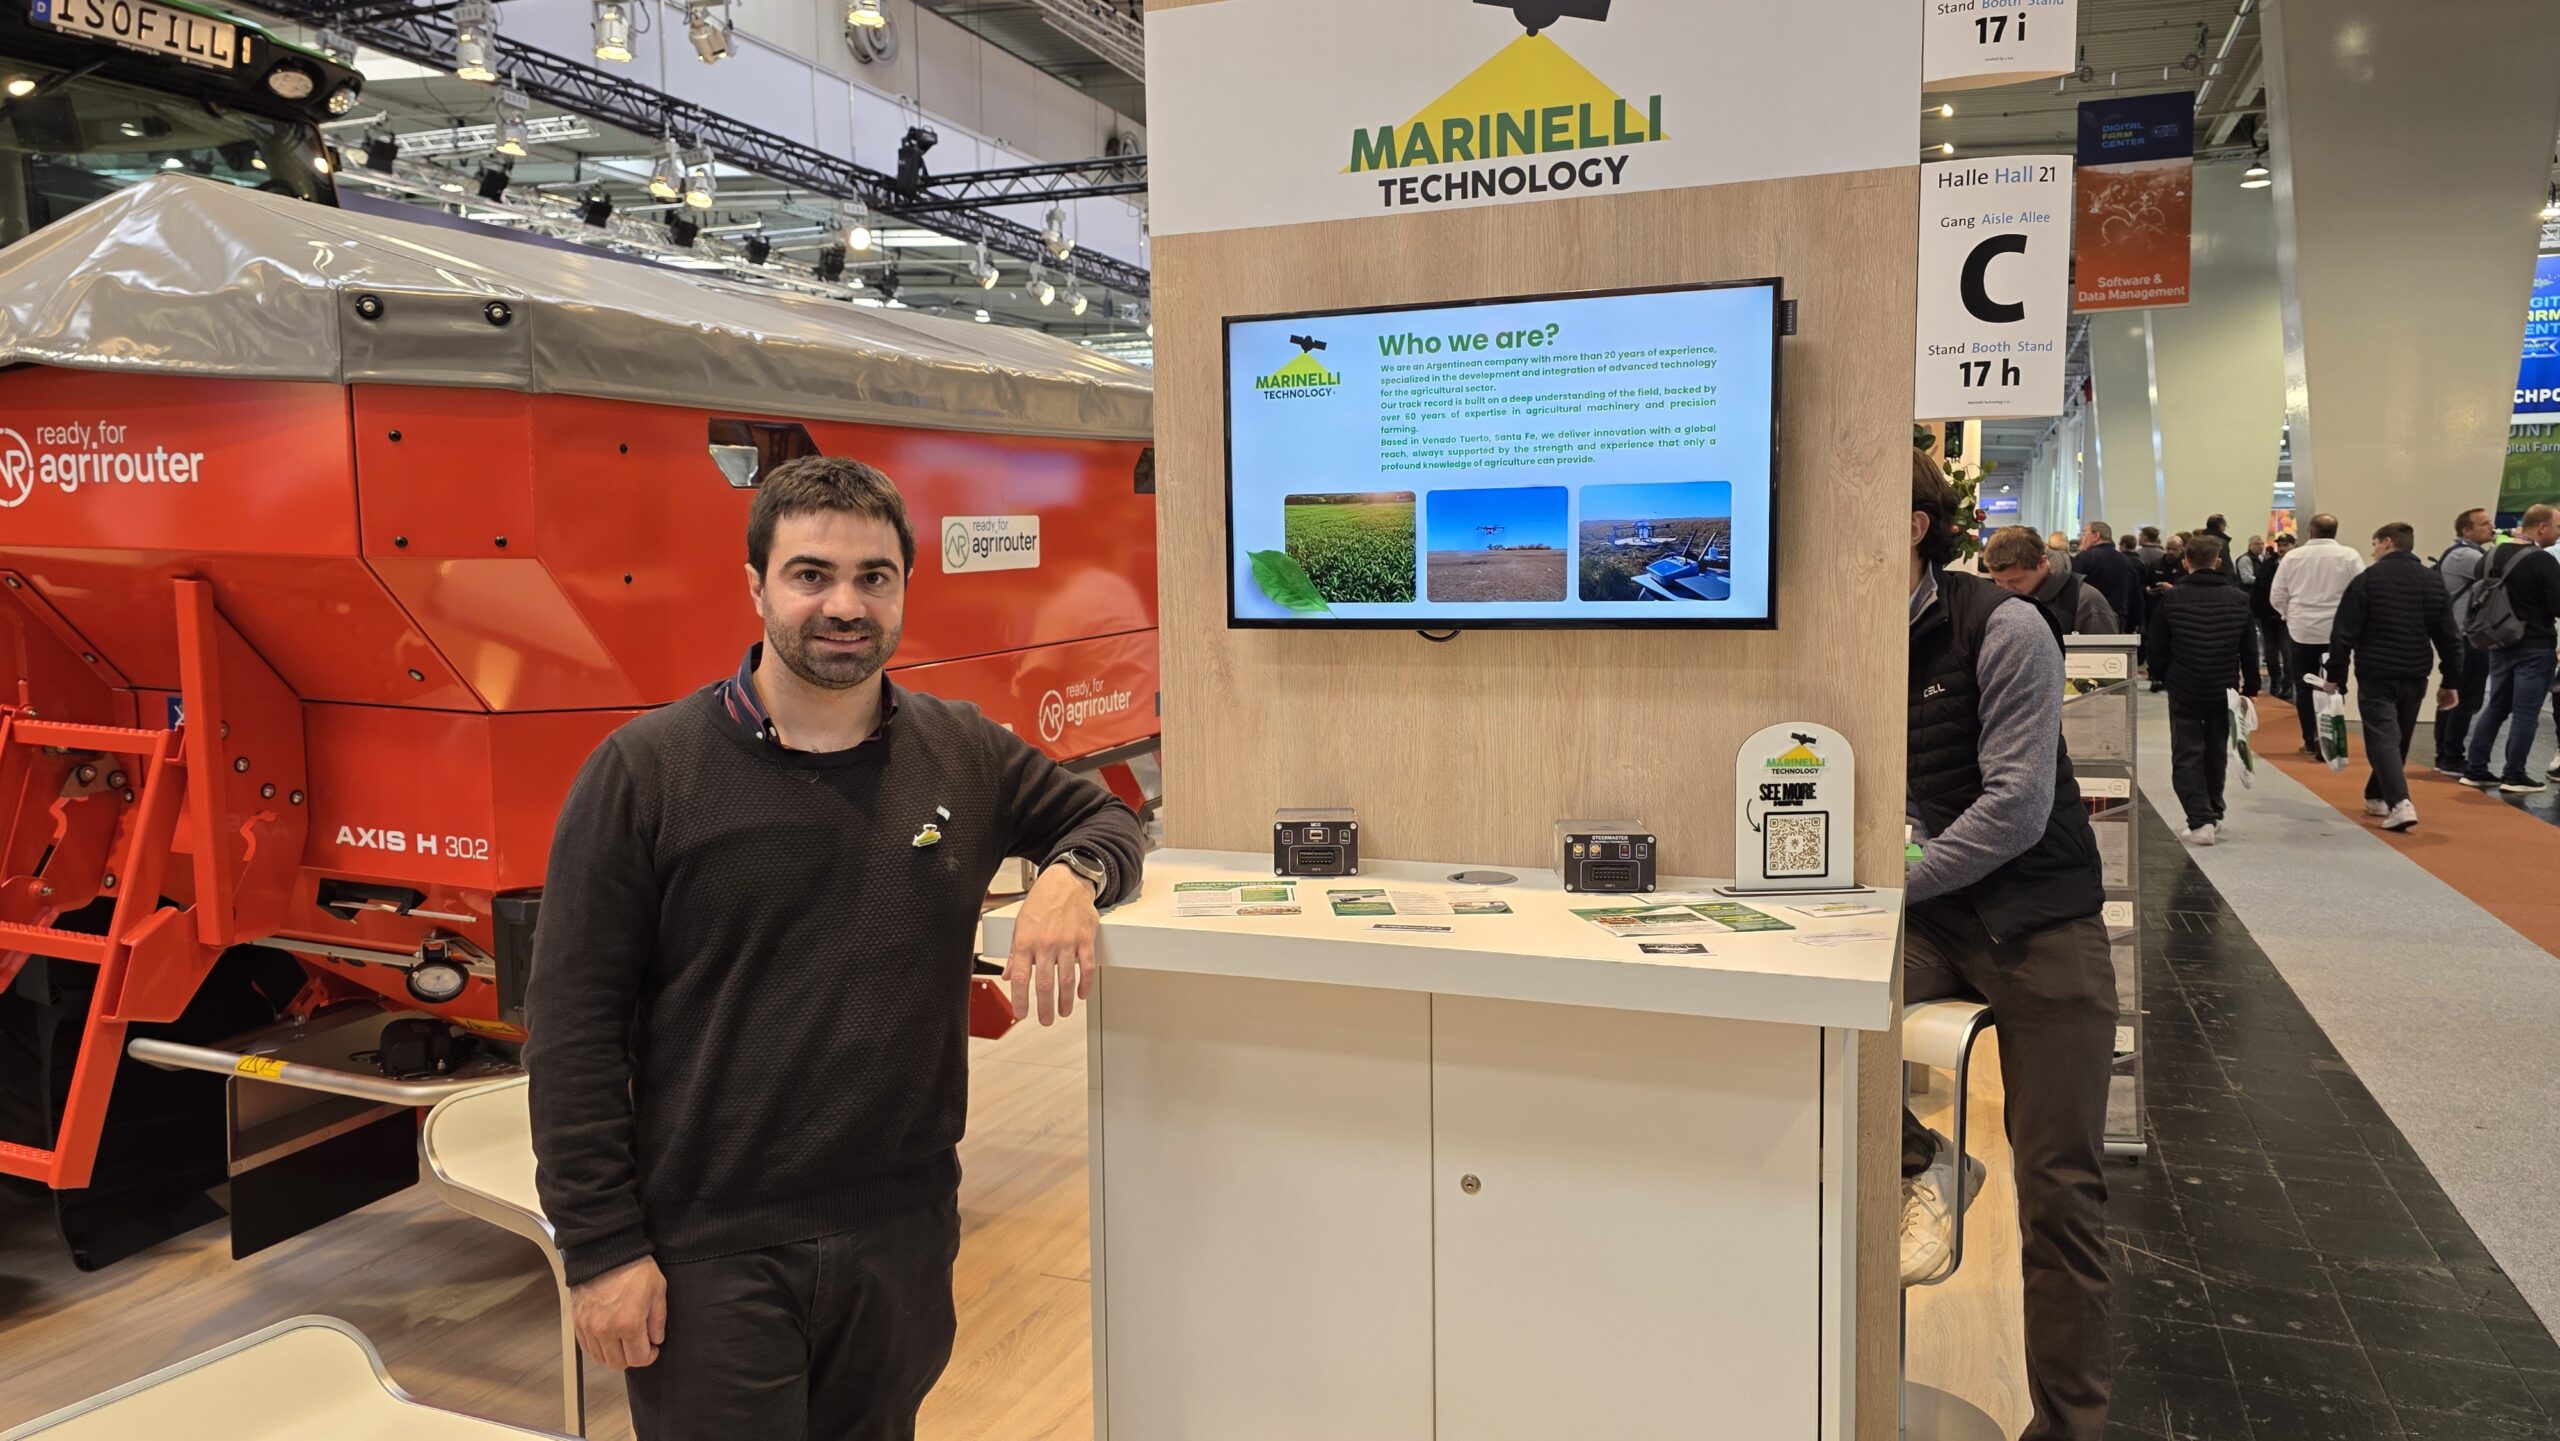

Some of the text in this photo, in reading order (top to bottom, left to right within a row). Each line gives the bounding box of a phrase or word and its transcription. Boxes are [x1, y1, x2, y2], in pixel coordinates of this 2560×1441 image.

[1937, 0, 1975, 15] Stand
[1975, 12, 2026, 44] 17 i
[1350, 95, 1662, 173] MARINELLI
[2101, 121, 2144, 133] DIGITAL
[2101, 130, 2133, 141] FARM
[2101, 137, 2145, 148] CENTER
[1378, 155, 1629, 207] TECHNOLOGY
[1938, 165, 2056, 188] Halle Hall 21
[1940, 212, 2051, 229] Gang Aisle Allee
[1960, 233, 2028, 324] C
[2097, 273, 2163, 288] Software &
[2078, 286, 2186, 302] Data Management
[1379, 323, 1560, 356] Who we are?
[1928, 340, 2053, 356] Stand Booth Stand
[1381, 345, 1717, 372] We are an Argentinean company with more than 20 years of experience,
[1256, 372, 1340, 389] MARINELLI
[1381, 358, 1717, 386] specialized in the development and integration of advanced technology
[1959, 358, 2020, 387] 17 h
[1264, 388, 1332, 399] TECHNOLOGY
[1381, 384, 1496, 397] for the agricultural sector.
[1381, 401, 1397, 410] Our
[1398, 399, 1422, 409] track
[1424, 398, 1453, 407] record
[1455, 397, 1463, 406] is
[1464, 395, 1486, 405] built
[1487, 396, 1500, 404] on
[1509, 393, 1533, 404] deep
[1535, 390, 1605, 402] understanding
[1608, 389, 1617, 398] of
[1619, 388, 1635, 397] the
[1637, 387, 1662, 397] field,
[1664, 385, 1701, 395] backed
[1703, 385, 1717, 395] by
[1381, 398, 1717, 422] over 60 years of expertise in agricultural machinery and precision
[37, 420, 127, 450] ready for
[1381, 424, 1419, 434] farming.
[1381, 437, 1408, 446] Based
[1410, 437, 1419, 445] in
[1422, 434, 1457, 444] Venado
[1459, 434, 1491, 444] Tuerto,
[1494, 433, 1522, 441] Santa
[1525, 432, 1538, 441] Fe,
[1558, 429, 1590, 439] deliver
[1594, 426, 1646, 437] innovation
[1649, 425, 1671, 435] with
[1674, 426, 1681, 434] a
[1684, 424, 1716, 435] global
[1381, 450, 1409, 459] reach,
[1412, 448, 1444, 459] always
[1447, 447, 1495, 457] supported
[1498, 445, 1510, 456] by
[1514, 445, 1529, 453] the
[1533, 442, 1573, 454] strength
[1577, 442, 1596, 451] and
[1600, 440, 1654, 451] experience
[1658, 438, 1679, 447] that
[1683, 438, 1705, 448] only
[40, 442, 204, 493] agrirouter
[1381, 455, 1596, 472] profound knowledge of agriculture can provide.
[973, 518, 1009, 532] ready for
[972, 530, 1037, 558] agrirouter
[1066, 678, 1104, 698] ready for
[1066, 690, 1131, 726] agrirouter
[1766, 757, 1825, 767] MARINELLI
[1759, 782, 1817, 801] SEE MORE
[335, 825, 489, 860] AXIS H 30.2
